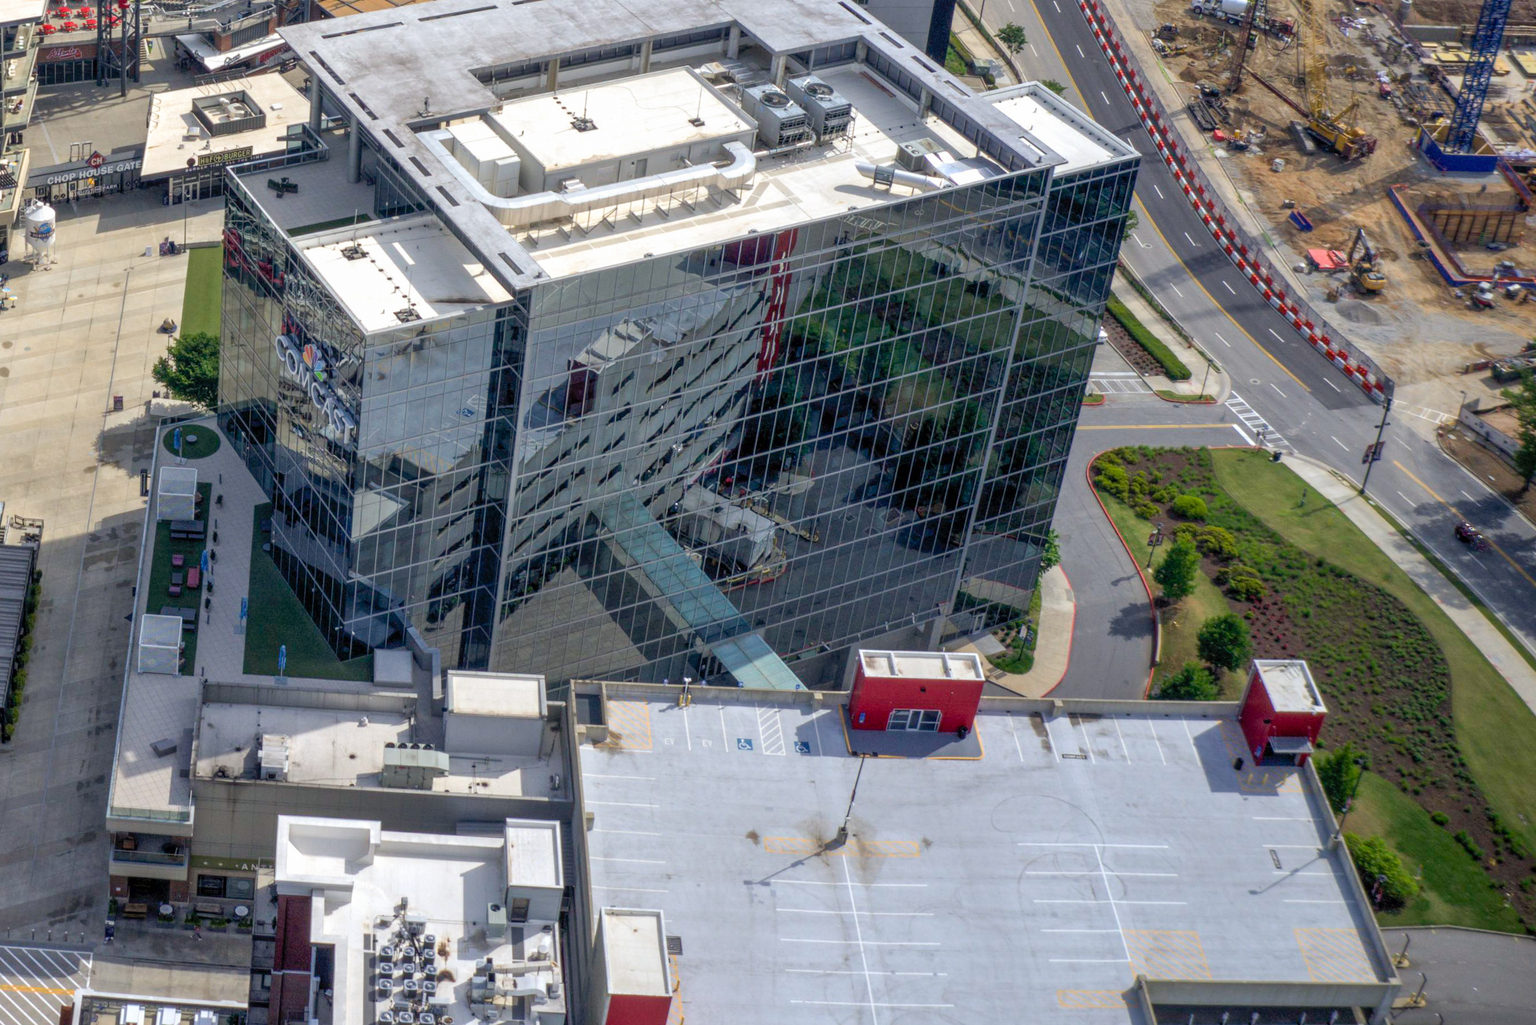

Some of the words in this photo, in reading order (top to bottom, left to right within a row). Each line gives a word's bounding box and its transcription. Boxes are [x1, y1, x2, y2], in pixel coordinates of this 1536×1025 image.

[224, 149, 251, 160] BURGER
[91, 157, 103, 166] CH
[47, 171, 76, 185] CHOP
[79, 166, 113, 179] HOUSE
[116, 160, 142, 172] GATE
[276, 336, 355, 444] COMCAST
[664, 737, 675, 746] EV
[702, 739, 713, 748] EV
